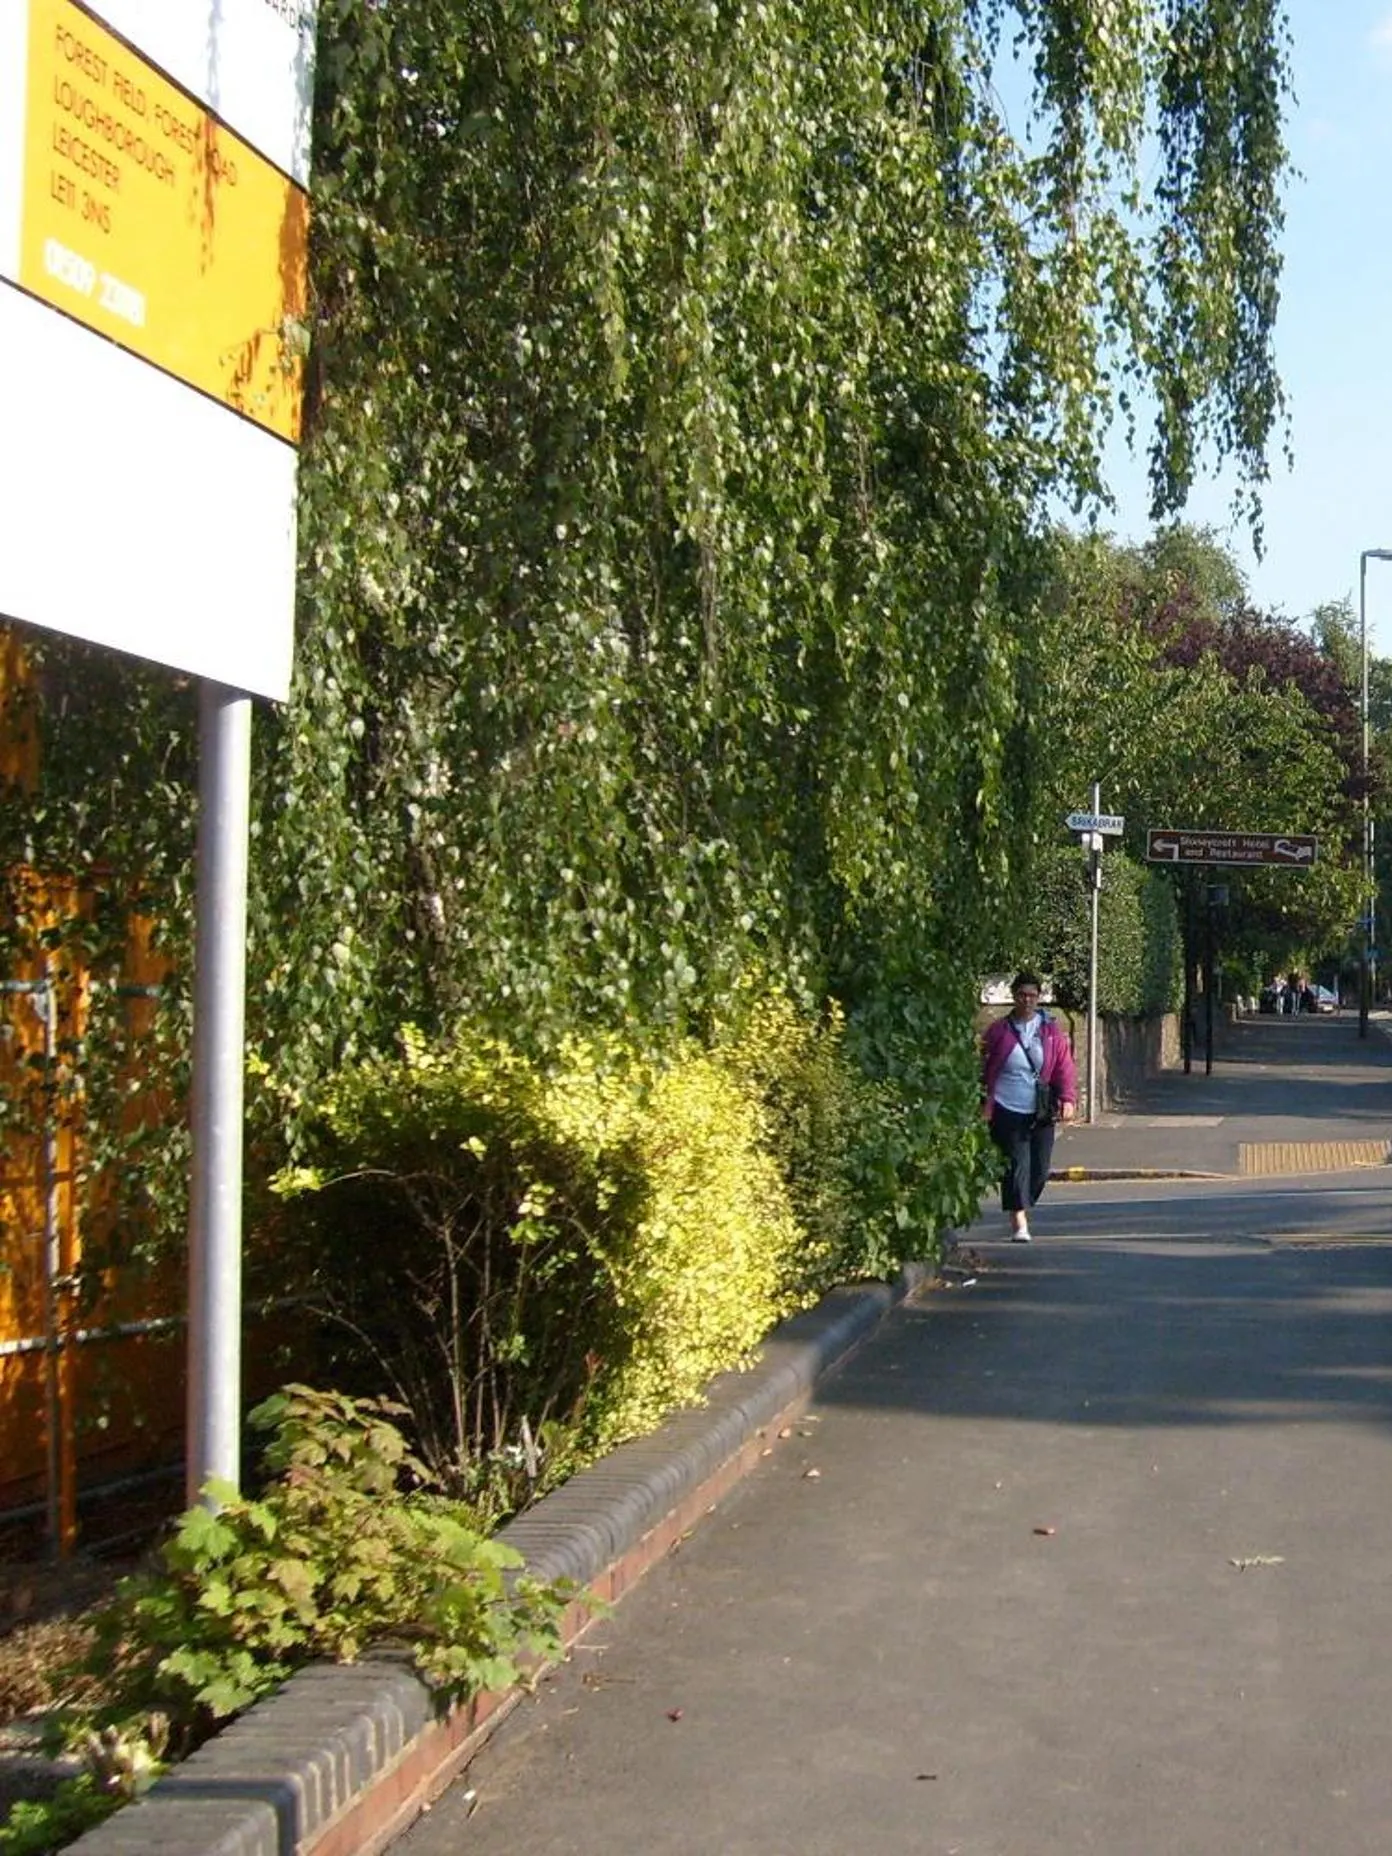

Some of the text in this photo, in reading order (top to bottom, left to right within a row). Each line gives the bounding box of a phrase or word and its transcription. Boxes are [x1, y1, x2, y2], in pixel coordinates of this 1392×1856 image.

[56, 24, 108, 86] FOREST
[53, 119, 120, 194] LEICESTER
[54, 74, 176, 188] LOUGHBOROUGH
